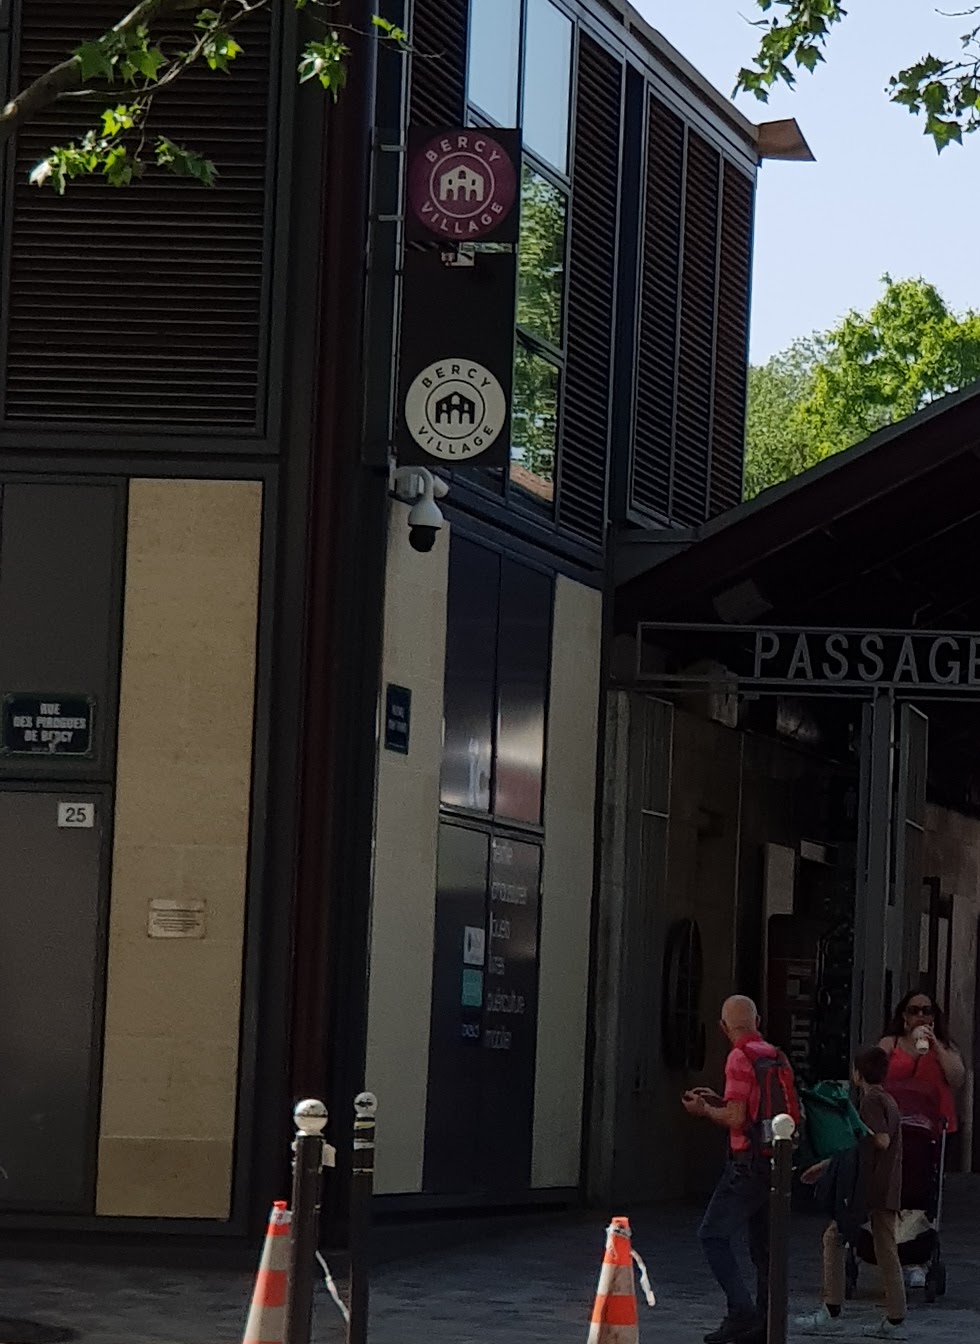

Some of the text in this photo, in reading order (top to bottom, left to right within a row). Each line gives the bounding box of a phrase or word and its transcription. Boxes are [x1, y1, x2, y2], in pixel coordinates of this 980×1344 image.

[424, 134, 502, 164] BERCY
[420, 201, 505, 235] VILLAGE
[420, 363, 493, 390] BERCY
[417, 422, 495, 456] VILLAGE
[65, 807, 87, 823] 25
